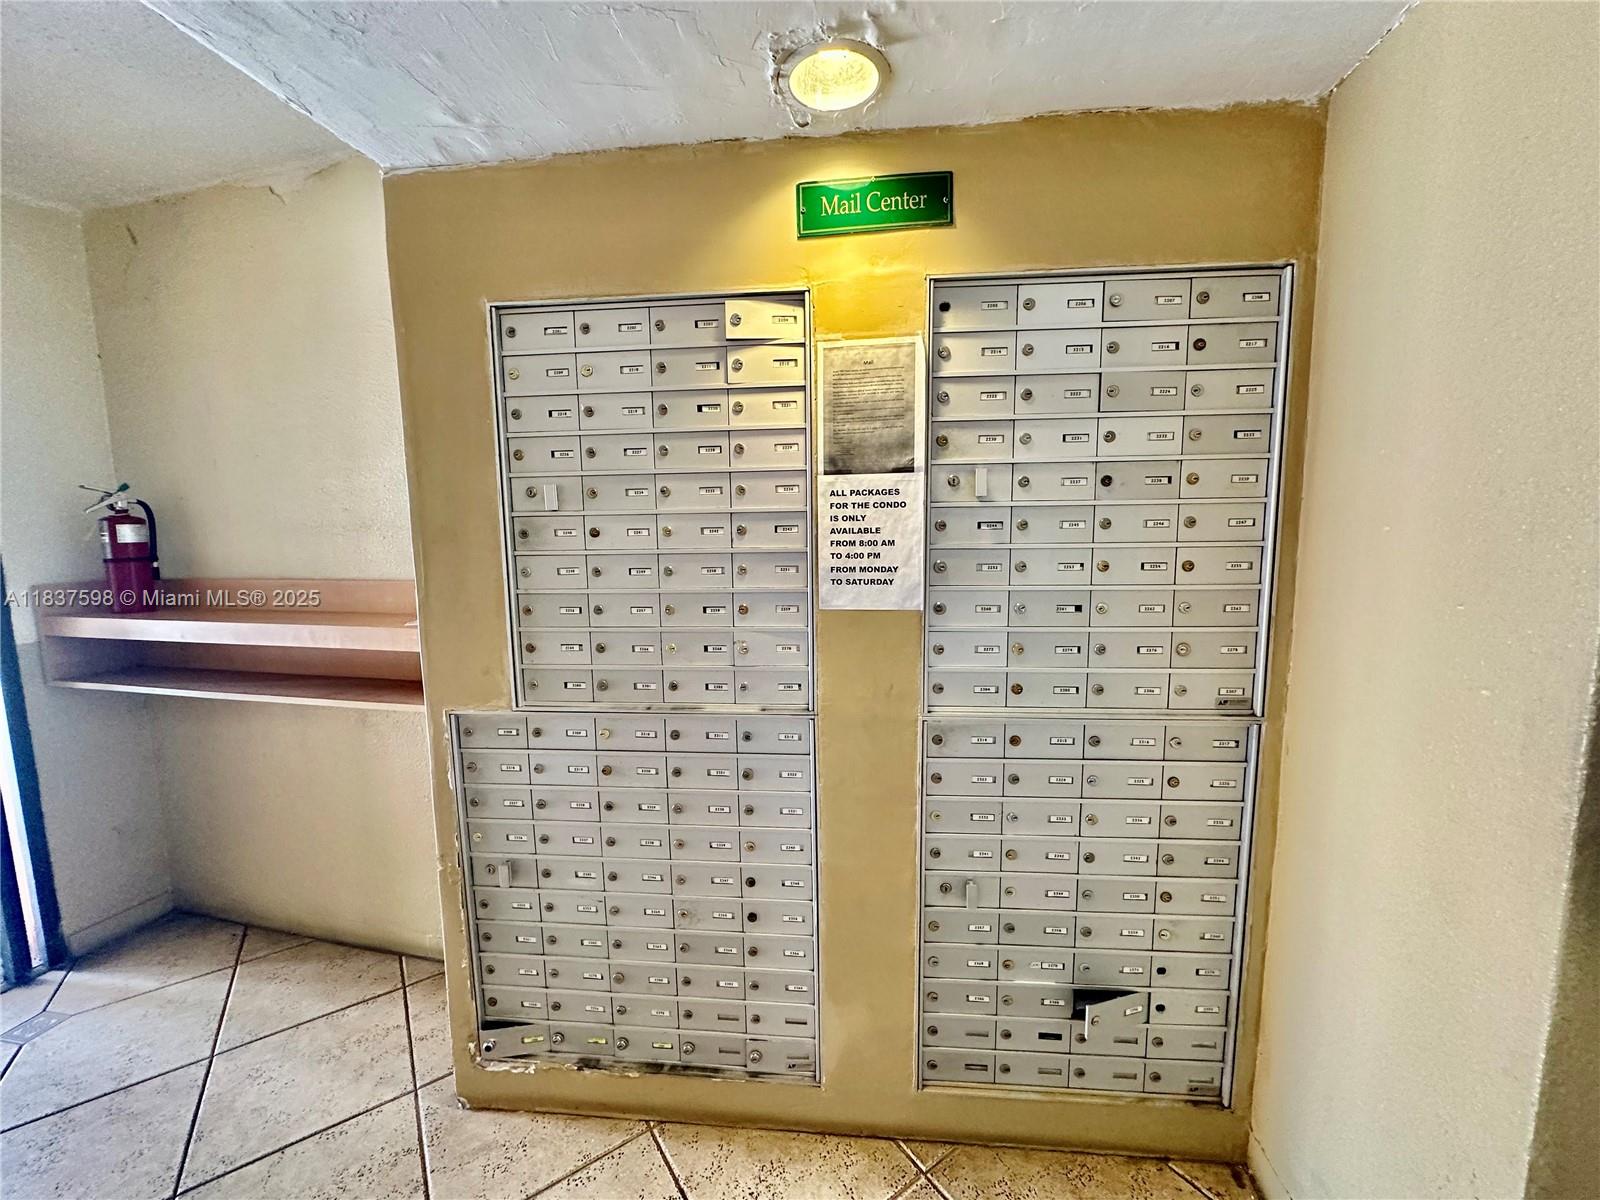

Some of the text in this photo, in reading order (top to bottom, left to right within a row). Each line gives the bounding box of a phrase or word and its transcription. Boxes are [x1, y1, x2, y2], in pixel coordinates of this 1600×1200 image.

[820, 192, 927, 216] Mail Center
[850, 488, 900, 496] PACKAGES
